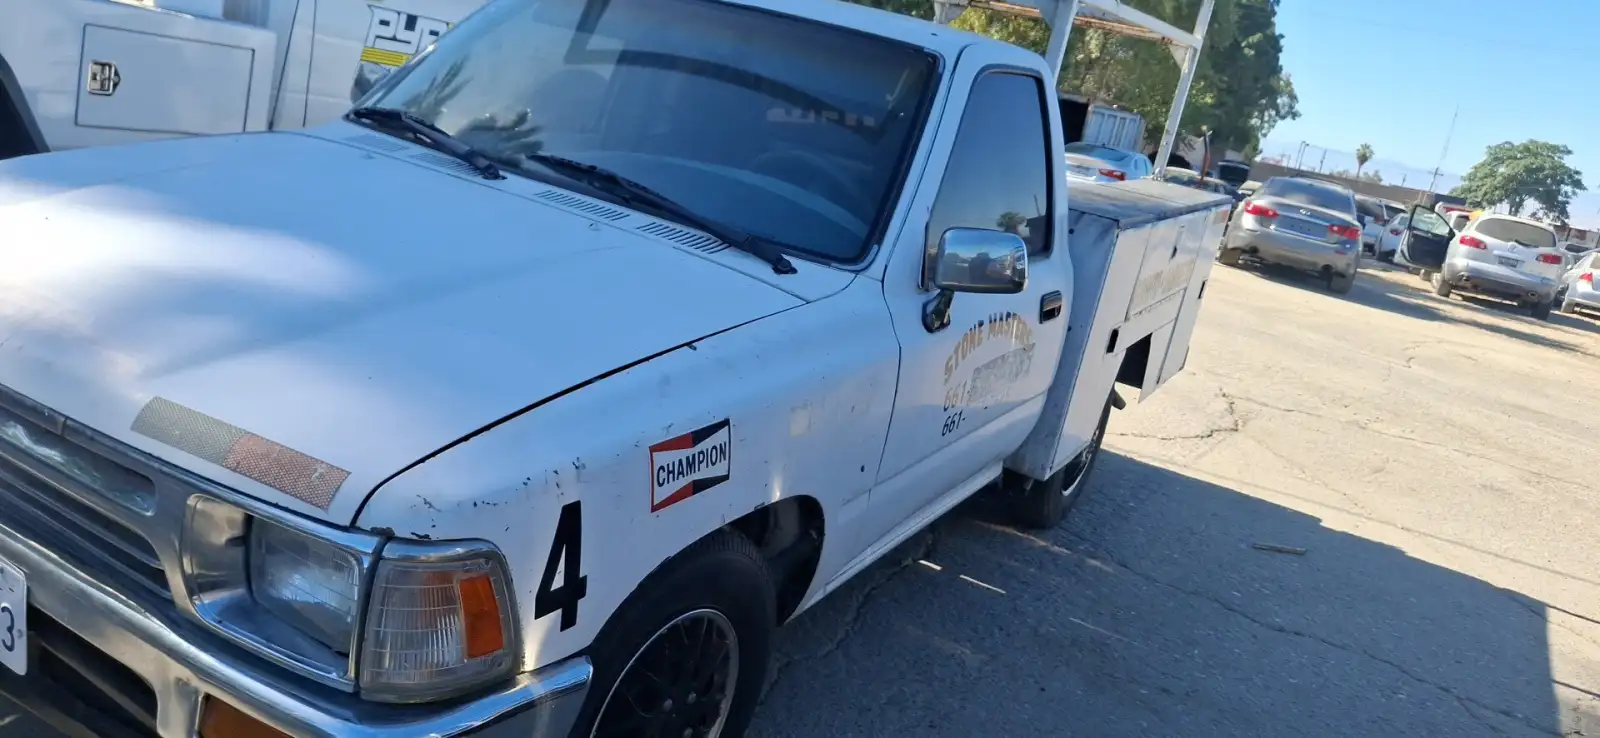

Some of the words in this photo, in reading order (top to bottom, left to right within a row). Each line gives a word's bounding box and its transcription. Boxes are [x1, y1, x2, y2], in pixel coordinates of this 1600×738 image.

[943, 320, 984, 386] STONE
[941, 409, 966, 437] 661-
[656, 441, 727, 488] CHAMPION
[534, 500, 587, 632] 4
